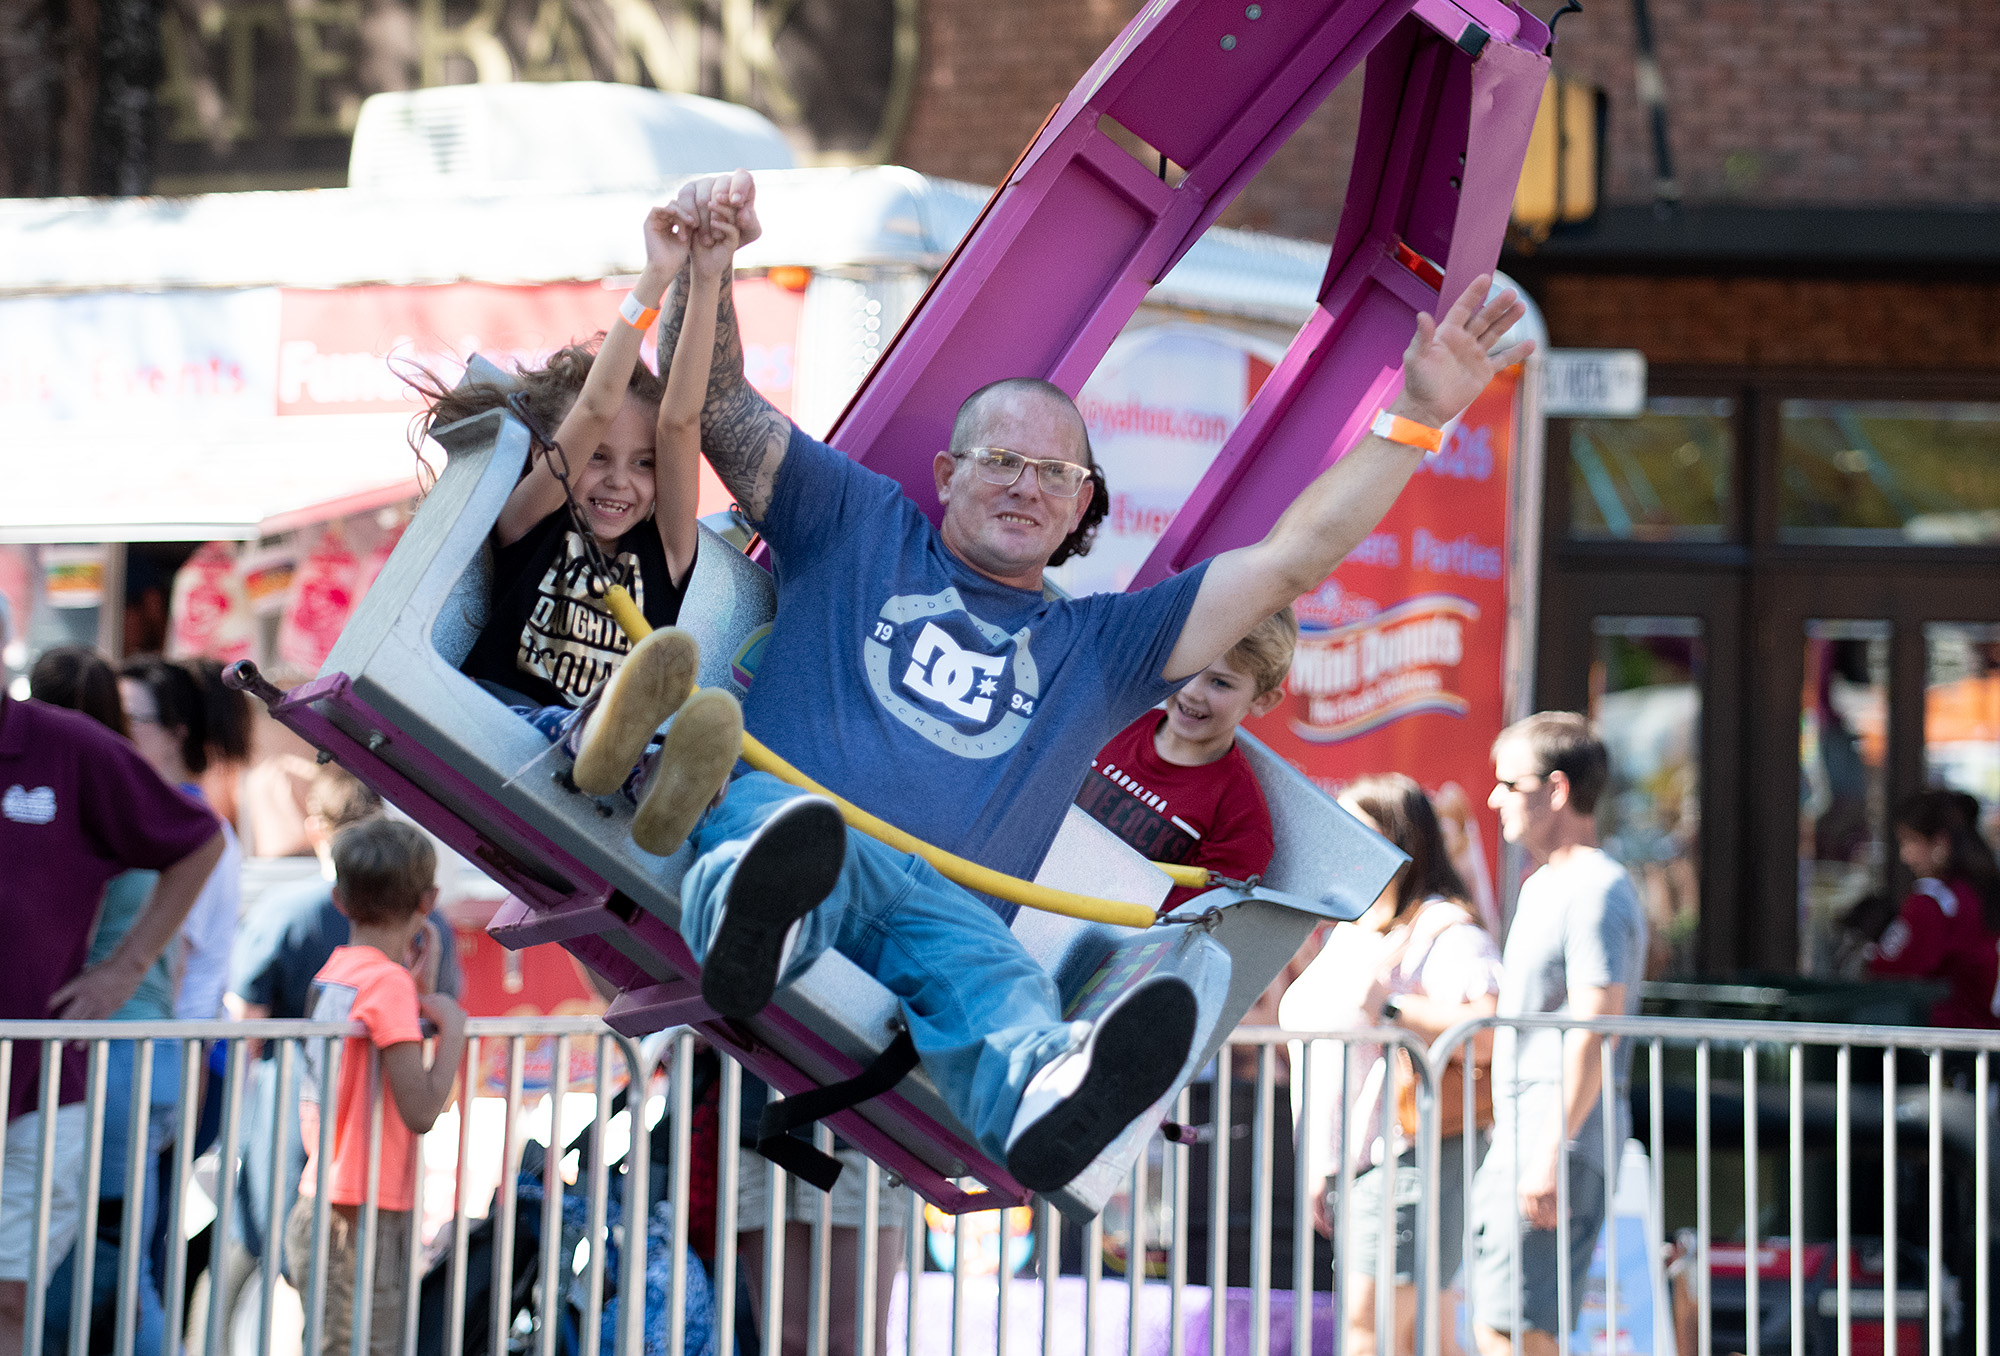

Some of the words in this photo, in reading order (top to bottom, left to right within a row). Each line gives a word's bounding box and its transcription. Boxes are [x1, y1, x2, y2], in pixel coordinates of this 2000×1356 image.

[1411, 526, 1501, 581] Parties
[529, 595, 634, 652] DAUGHTE
[1289, 632, 1359, 697] Mini
[1361, 615, 1464, 682] Donuts
[872, 620, 894, 642] 19
[1010, 692, 1034, 716] 94
[901, 620, 1008, 724] DC
[1102, 763, 1168, 814] CAROLINA
